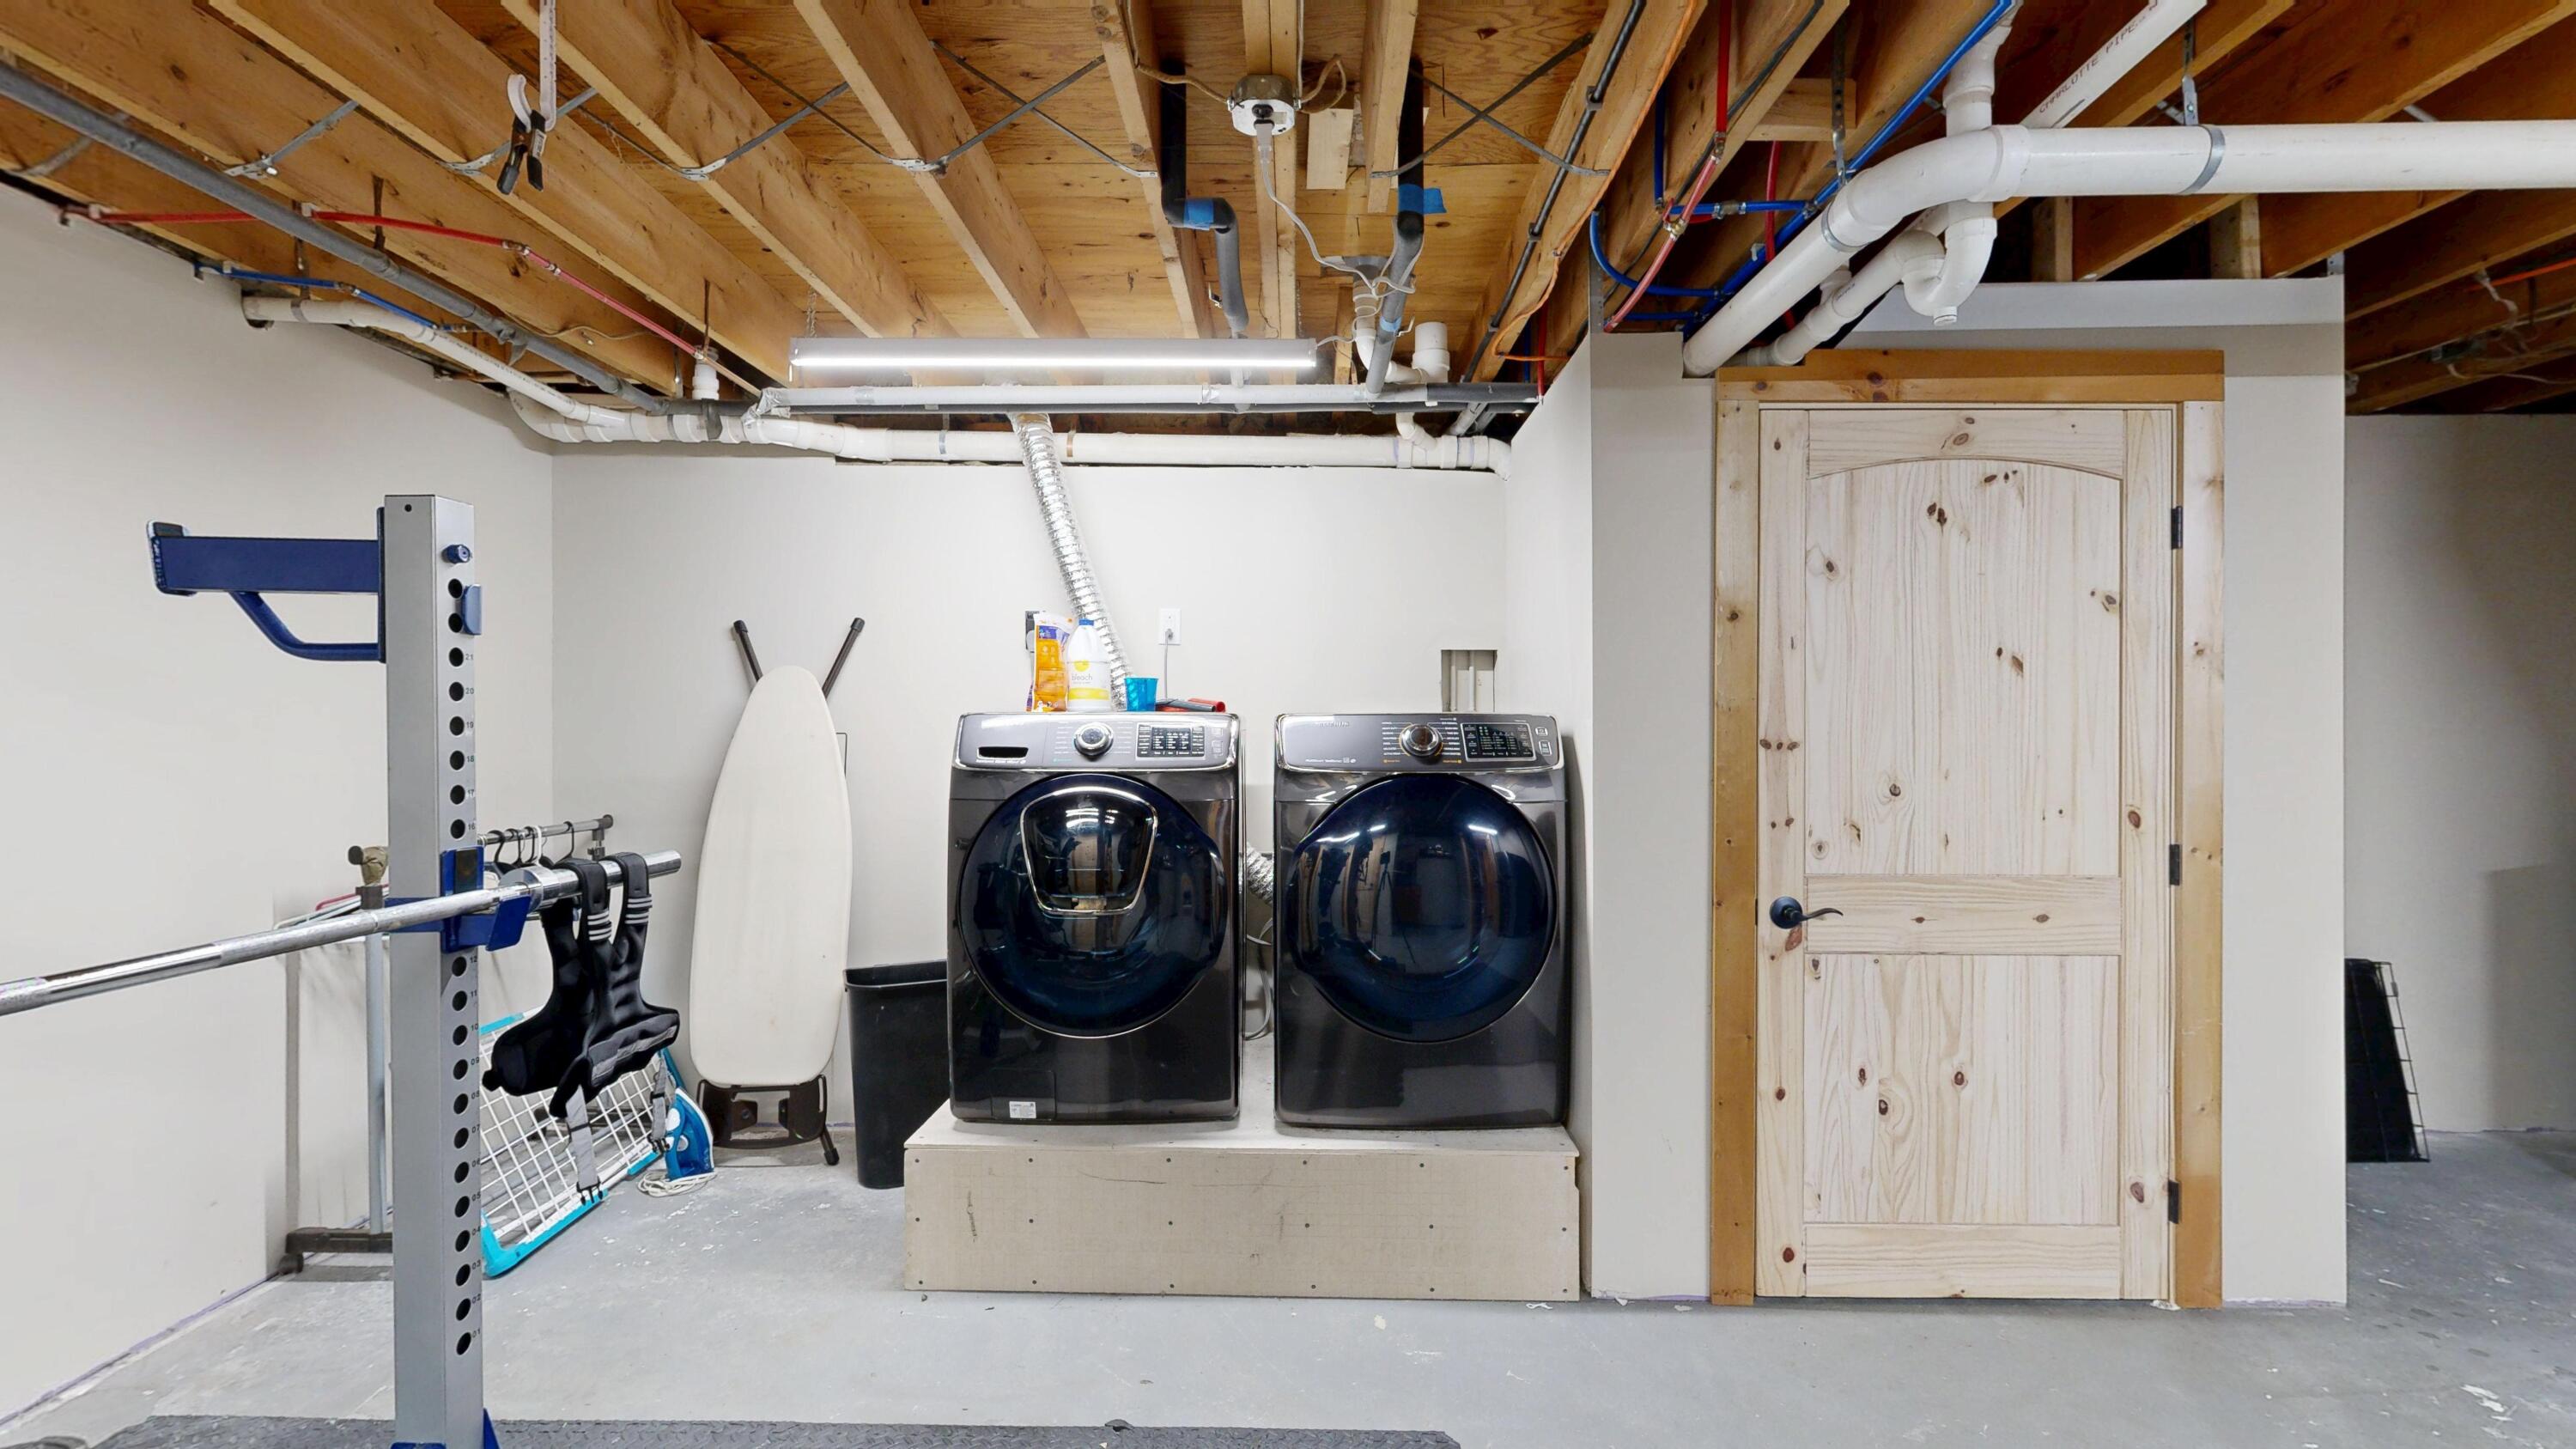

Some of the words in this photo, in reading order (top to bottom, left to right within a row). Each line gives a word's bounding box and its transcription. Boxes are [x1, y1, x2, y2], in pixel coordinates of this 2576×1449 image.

[2039, 57, 2099, 113] CHARLOTTE
[2105, 21, 2136, 53] PIPE
[471, 1056, 480, 1066] 09
[471, 1090, 480, 1099] 08
[471, 1123, 480, 1134] 07
[471, 1191, 481, 1202] 05
[471, 1259, 481, 1269] 03
[471, 1294, 481, 1304] 02
[472, 1328, 481, 1338] 01
